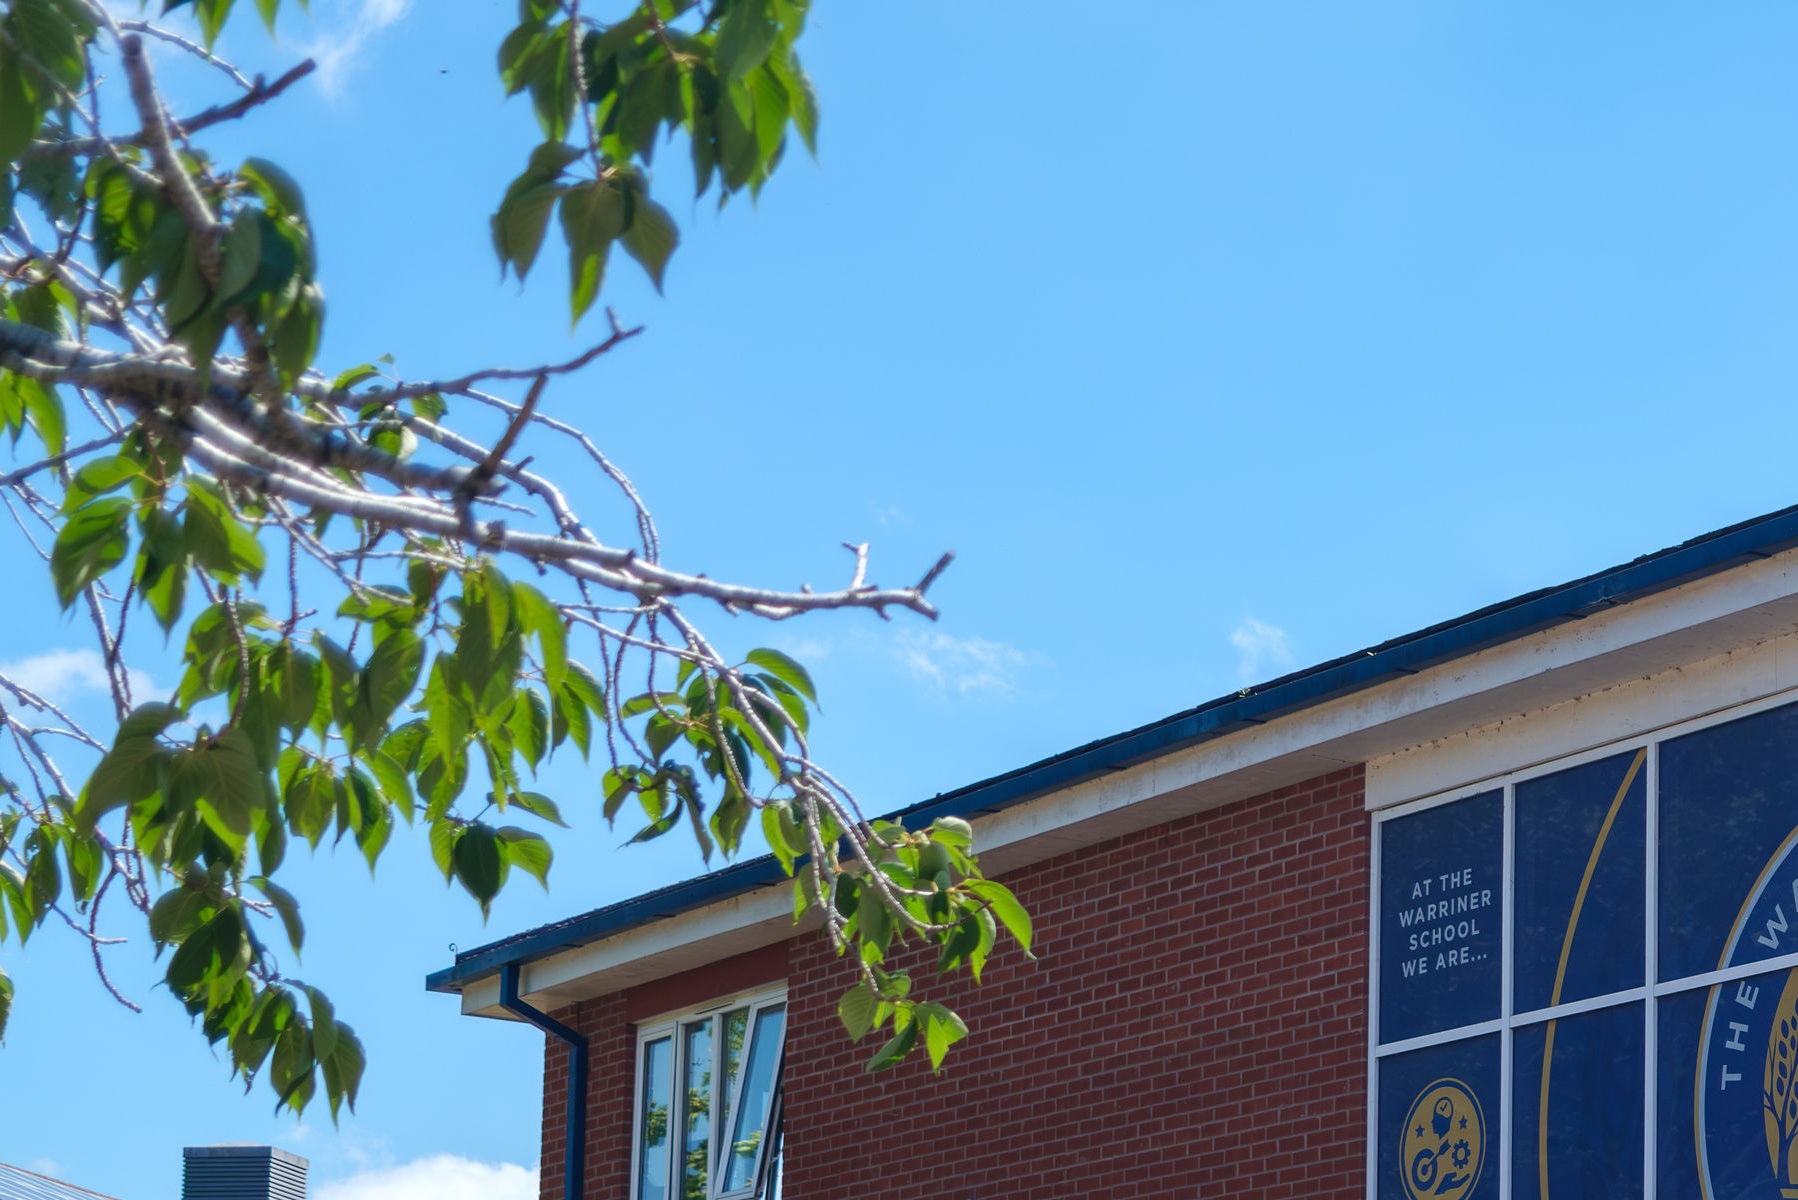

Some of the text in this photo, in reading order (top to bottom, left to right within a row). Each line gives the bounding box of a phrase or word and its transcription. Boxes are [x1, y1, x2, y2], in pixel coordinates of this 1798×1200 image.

[1411, 868, 1472, 900] AT THE
[1399, 889, 1492, 928] WARRINER
[1409, 919, 1480, 951] SCHOOL
[1401, 946, 1488, 978] WE ARE...
[1720, 980, 1760, 1091] THE
